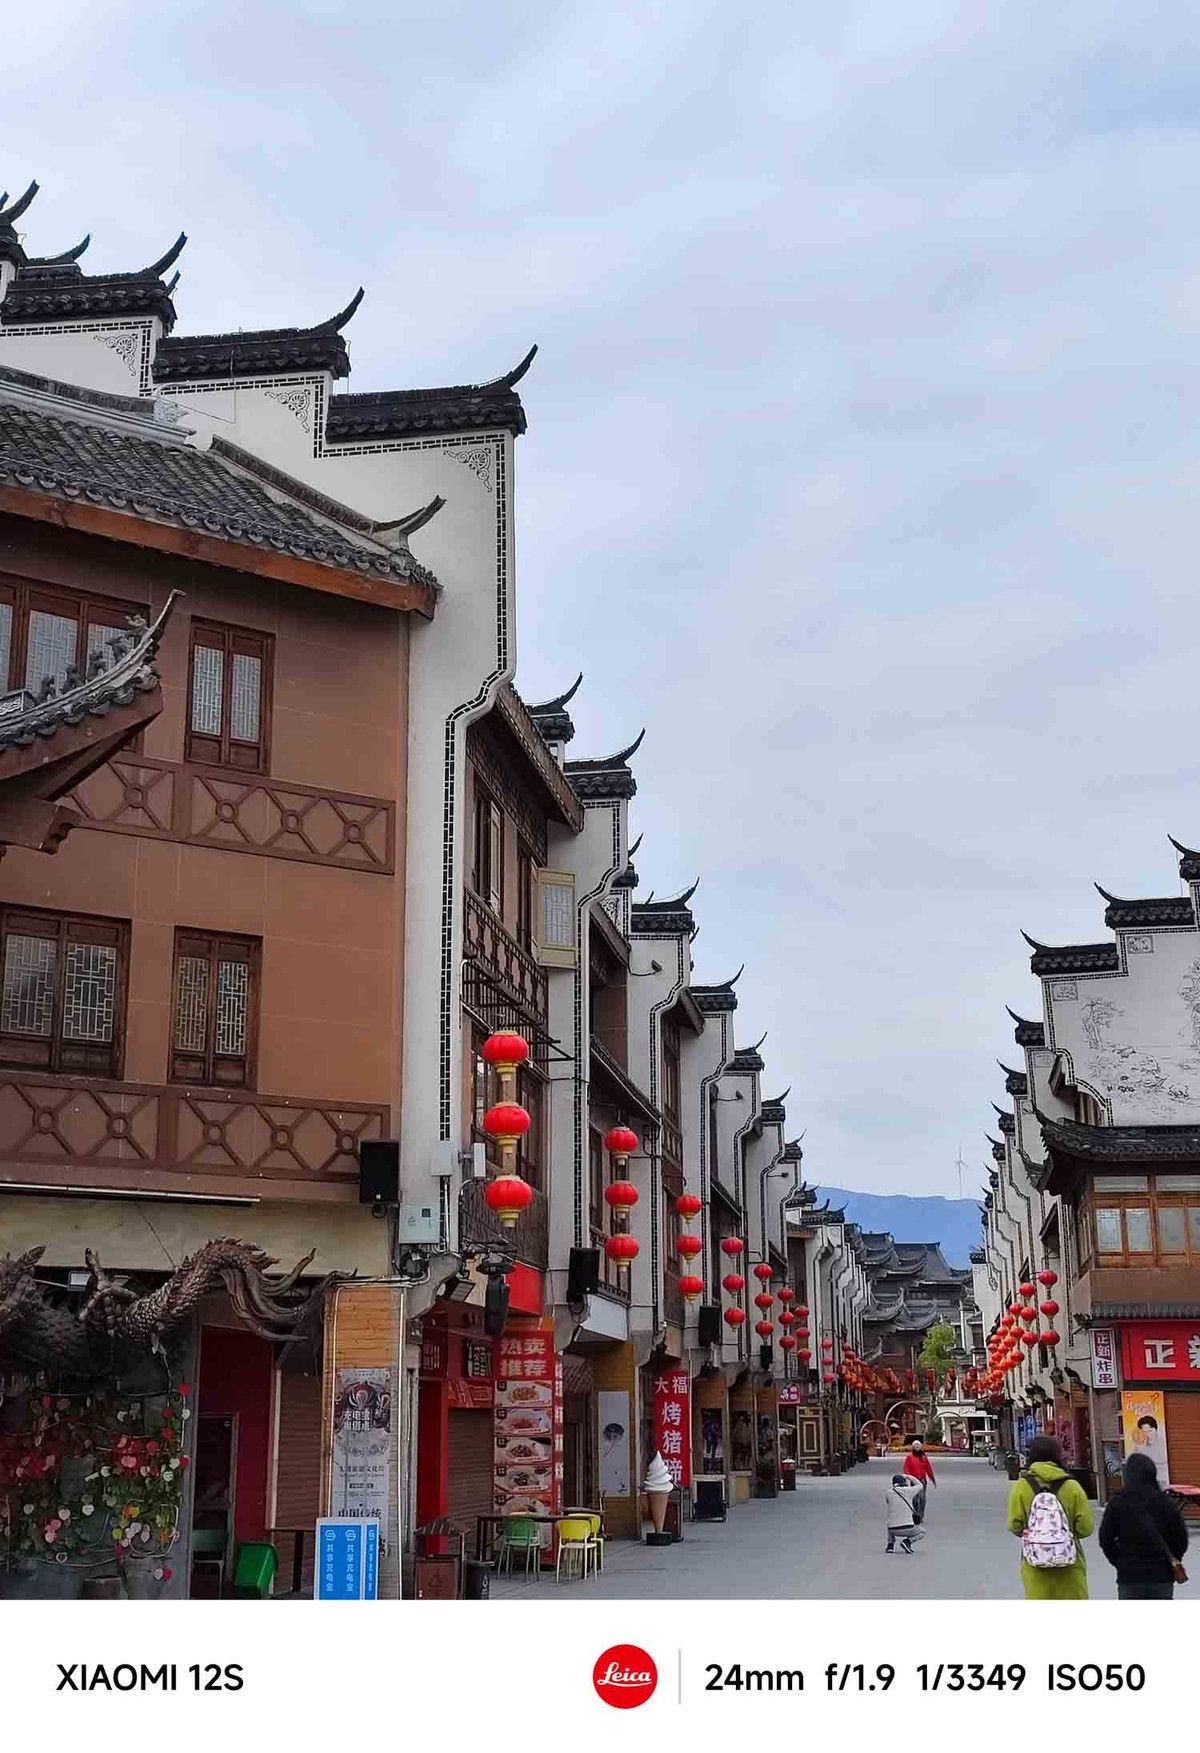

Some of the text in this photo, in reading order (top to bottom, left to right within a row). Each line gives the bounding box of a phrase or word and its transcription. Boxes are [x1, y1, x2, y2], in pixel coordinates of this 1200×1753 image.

[499, 1338, 546, 1355] 热卖
[499, 1360, 547, 1377] 推荐
[654, 1376, 688, 1395] 大福
